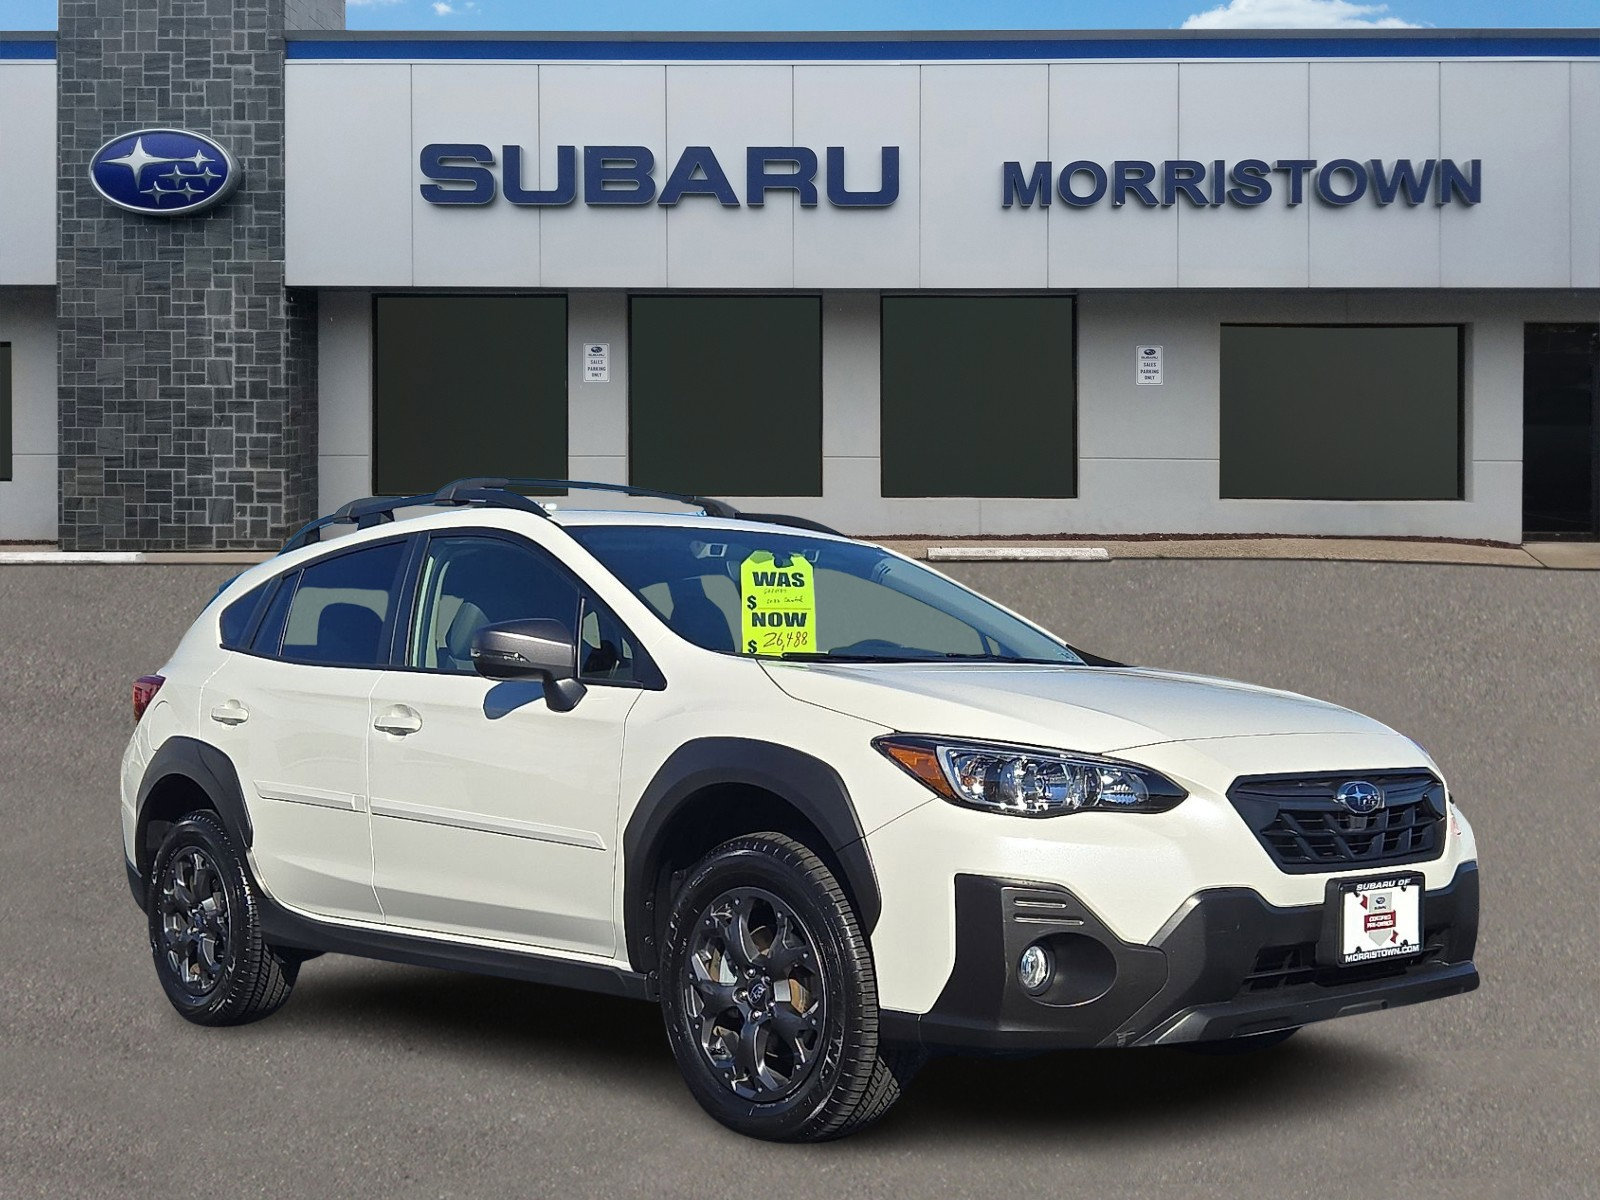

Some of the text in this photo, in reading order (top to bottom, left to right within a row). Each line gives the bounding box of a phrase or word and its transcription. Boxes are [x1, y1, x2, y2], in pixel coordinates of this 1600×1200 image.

[420, 143, 899, 206] SUBARU
[1002, 159, 1482, 207] MORRISTOWN
[752, 571, 805, 588] WAS
[747, 595, 757, 611] $
[751, 612, 807, 627] NOW
[748, 631, 808, 654] $ 26,488
[1356, 878, 1412, 891] SUBARU OF
[1345, 945, 1420, 963] MORRISTOWN.COM
